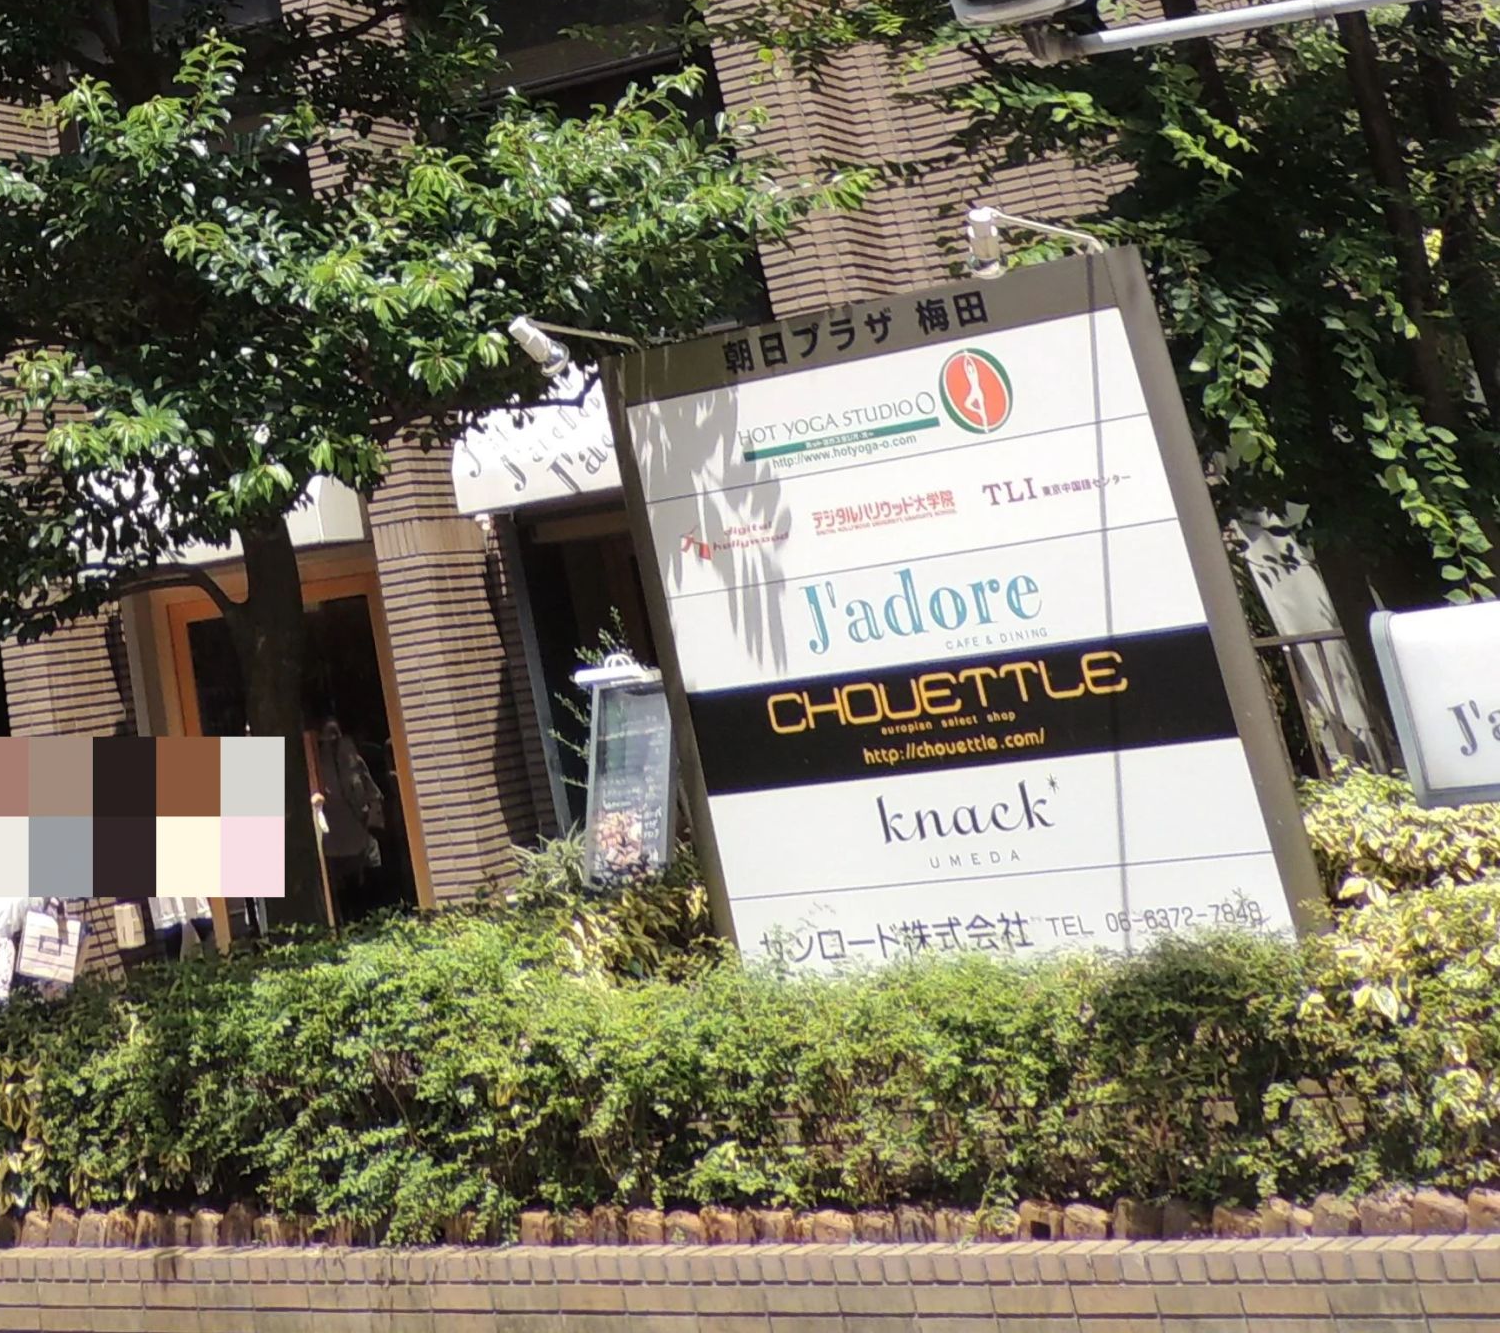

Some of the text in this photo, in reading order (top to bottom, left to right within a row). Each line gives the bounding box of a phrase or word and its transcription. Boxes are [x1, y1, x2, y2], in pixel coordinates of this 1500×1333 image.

[721, 290, 988, 375] 朝日プラザ 梅田
[738, 424, 777, 447] HOT
[782, 416, 839, 440] YOGA
[842, 398, 913, 428] STUDIO
[772, 433, 918, 470] http://www.hotyoga-o.com
[982, 477, 1038, 506] TLI
[812, 489, 956, 530] デジタルハリウッド大学院
[712, 531, 789, 551] hollywood
[723, 520, 773, 536] digital
[798, 567, 1043, 655] J'adore
[945, 626, 1049, 651] CAFE & DINING
[766, 650, 1129, 735] CHOUETTLE
[941, 715, 978, 729] select
[986, 710, 1017, 723] shop
[928, 849, 1021, 869] UMEDA
[1045, 915, 1094, 937] TEL
